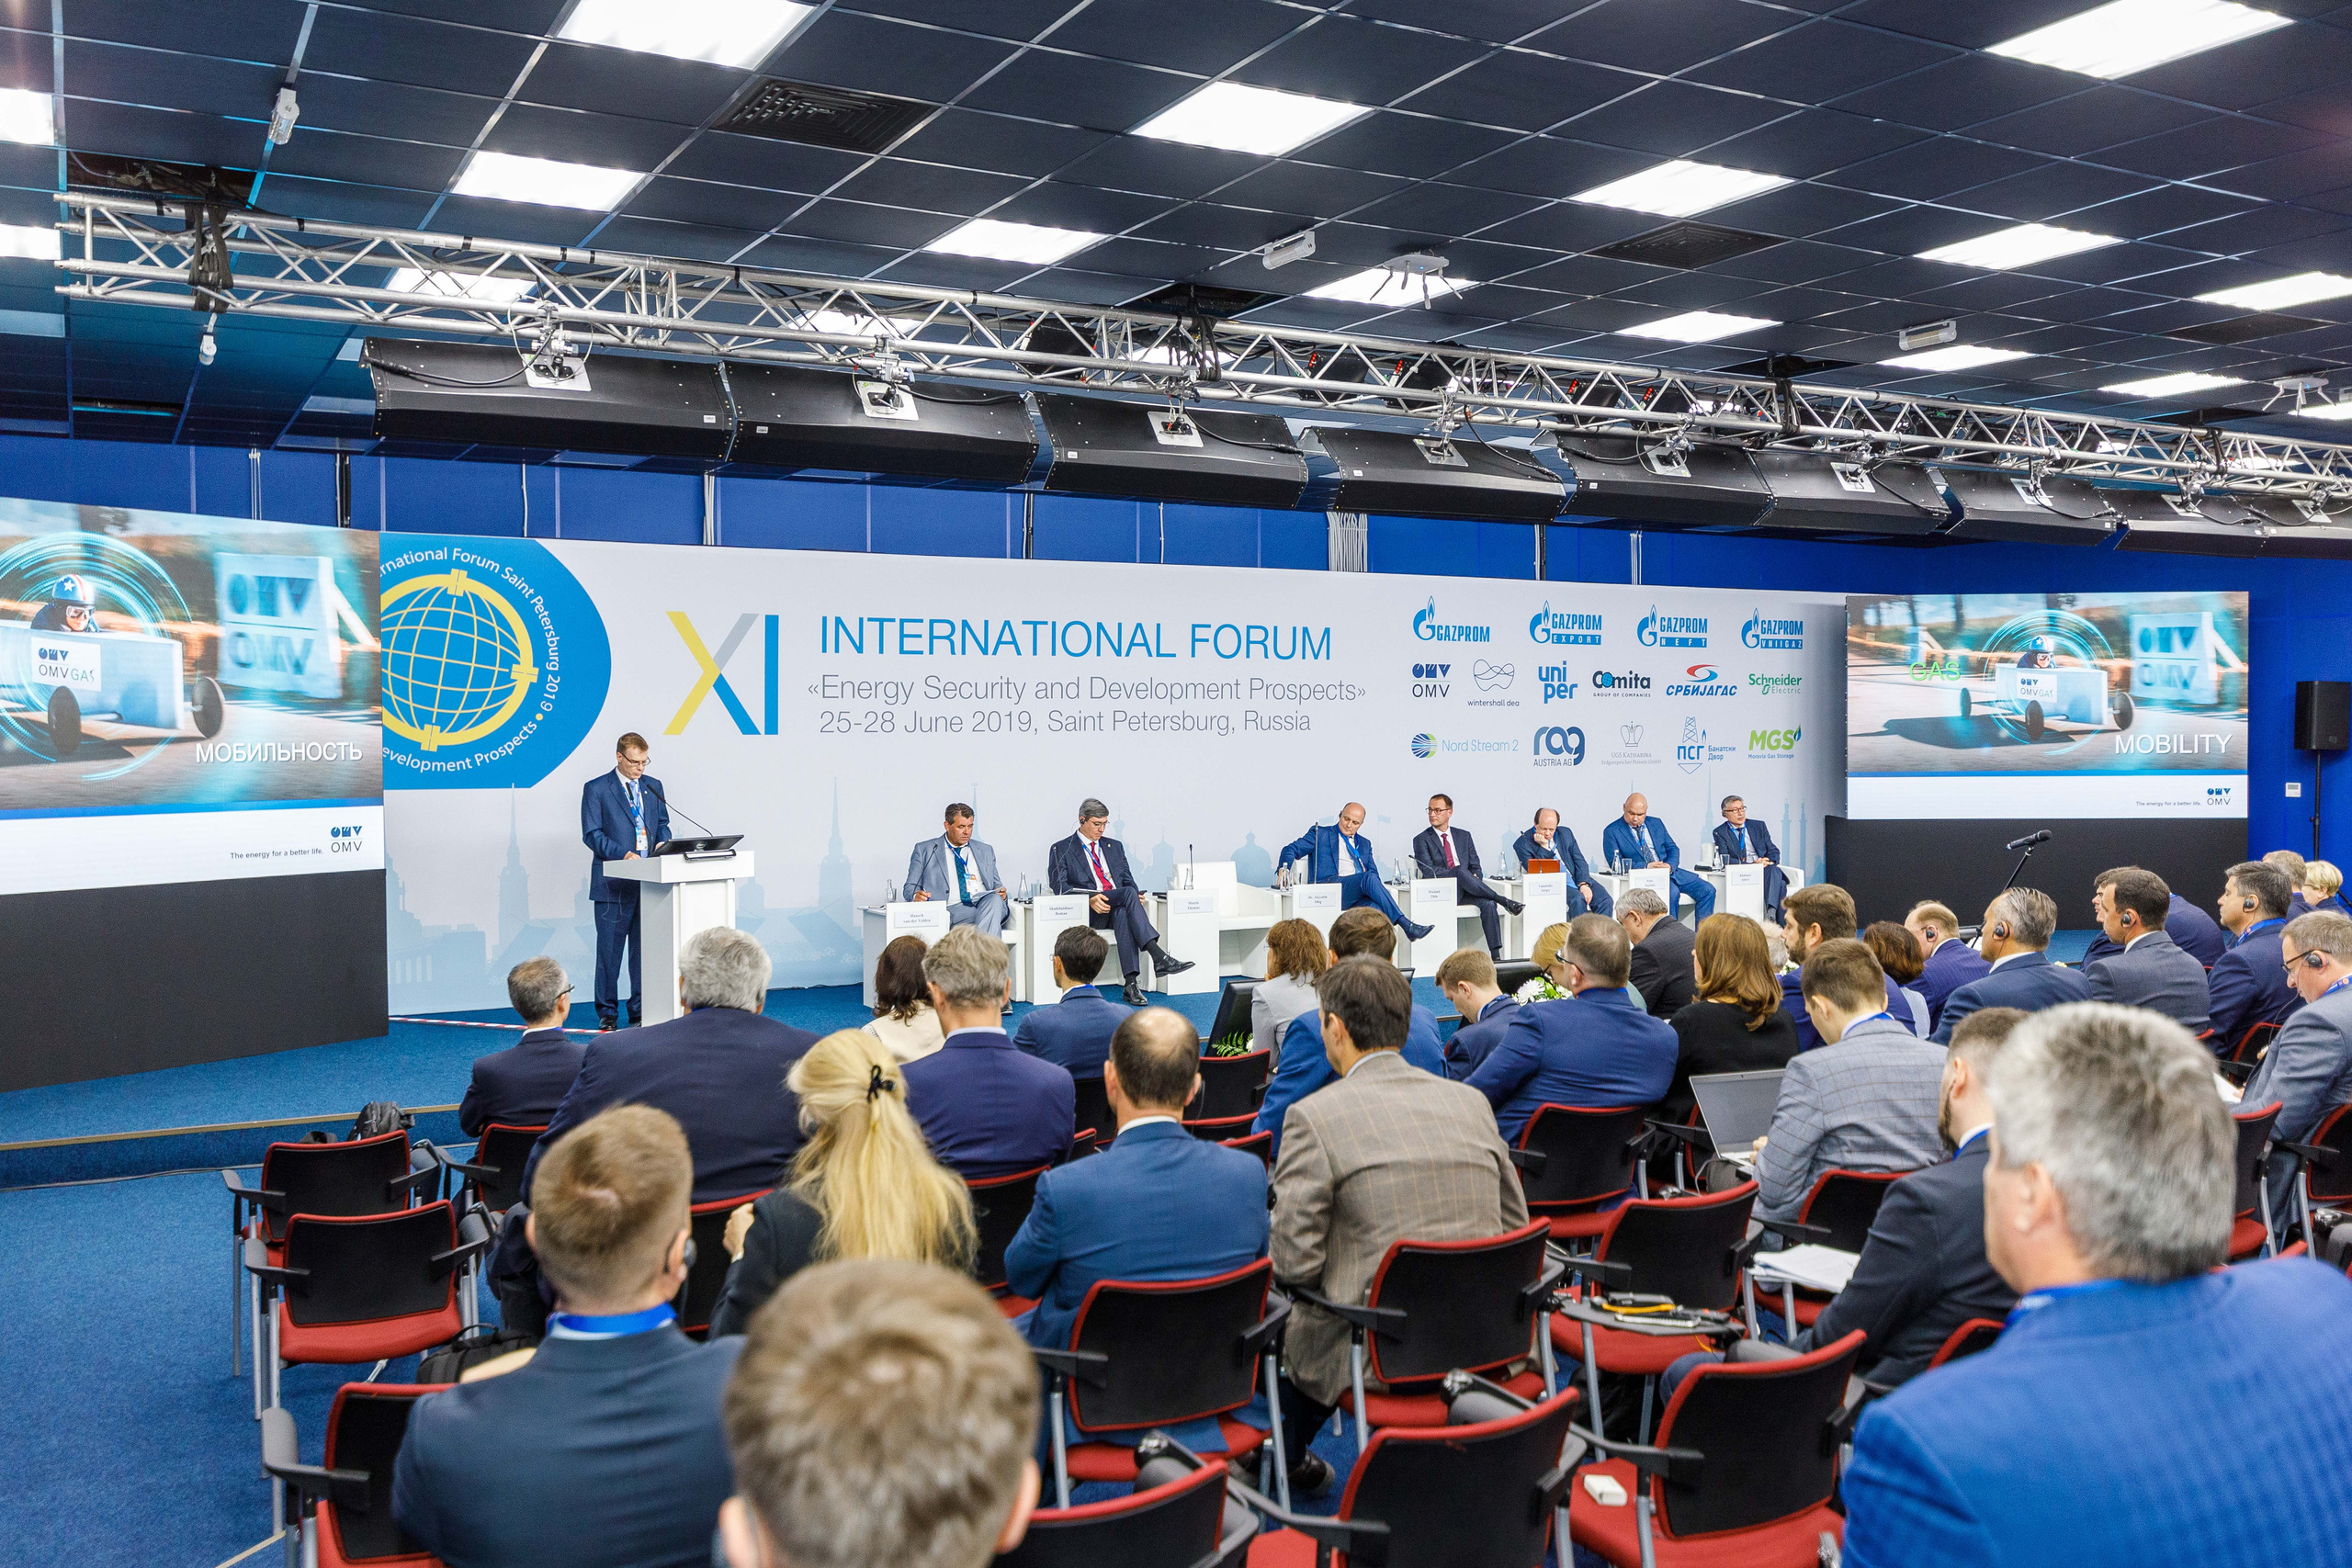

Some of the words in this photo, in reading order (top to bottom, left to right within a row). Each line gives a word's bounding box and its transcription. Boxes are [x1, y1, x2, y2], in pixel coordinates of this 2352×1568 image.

[380, 547, 447, 577] rnational
[452, 548, 500, 573] Forum
[501, 567, 535, 598] Saint
[1552, 614, 1602, 630] GAZPROM
[1659, 617, 1708, 634] GAZPROM
[1760, 619, 1804, 636] GAZPROM
[530, 595, 560, 671] Petersburg
[820, 615, 1177, 659] INTERNATIONAL
[1190, 623, 1331, 660] FORUM
[1436, 625, 1490, 643] GAZPROM
[1554, 635, 1600, 644] EXPORT
[1661, 637, 1706, 647] NEFT
[1761, 639, 1803, 649] VNIIGAZ
[662, 610, 779, 735] XI
[1538, 660, 1567, 682] uni
[1748, 672, 1803, 686] Schneider
[1909, 661, 1962, 682] GAS
[1592, 671, 1651, 689] Comita
[540, 674, 560, 712] 2019
[808, 674, 915, 705] «Energy
[922, 675, 1026, 705] Security
[1035, 676, 1080, 701] and
[1090, 676, 1241, 705] Development
[1249, 677, 1366, 706] Prospects»
[1412, 683, 1450, 698] OMV
[1544, 682, 1578, 705] per
[1666, 684, 1738, 696] СРБИЈАГАС
[1771, 686, 1802, 694] Electric
[1467, 699, 1506, 707] wintershall
[820, 711, 896, 734] 25-28
[904, 710, 964, 734] June
[971, 710, 1038, 736] 2019,
[1047, 710, 1104, 732] Saint
[1113, 710, 1236, 737] Petersburg,
[1244, 710, 1311, 732] Russia
[474, 720, 537, 766] Prospects
[1442, 739, 1469, 751] Nord
[1470, 739, 1510, 751] Stream
[1512, 739, 1519, 751] 2
[1748, 729, 1795, 751] MGS
[2115, 734, 2233, 755] MOBILITY
[196, 741, 363, 763] МОБИЛЬНОСТЬ
[1677, 745, 1705, 761] ПСГ
[1707, 753, 1724, 762] Двор
[1533, 759, 1562, 767] AUSTRIA
[1563, 759, 1573, 767] AG
[2207, 797, 2232, 806] OMV
[331, 841, 363, 853] OMV
[245, 852, 270, 860] energy
